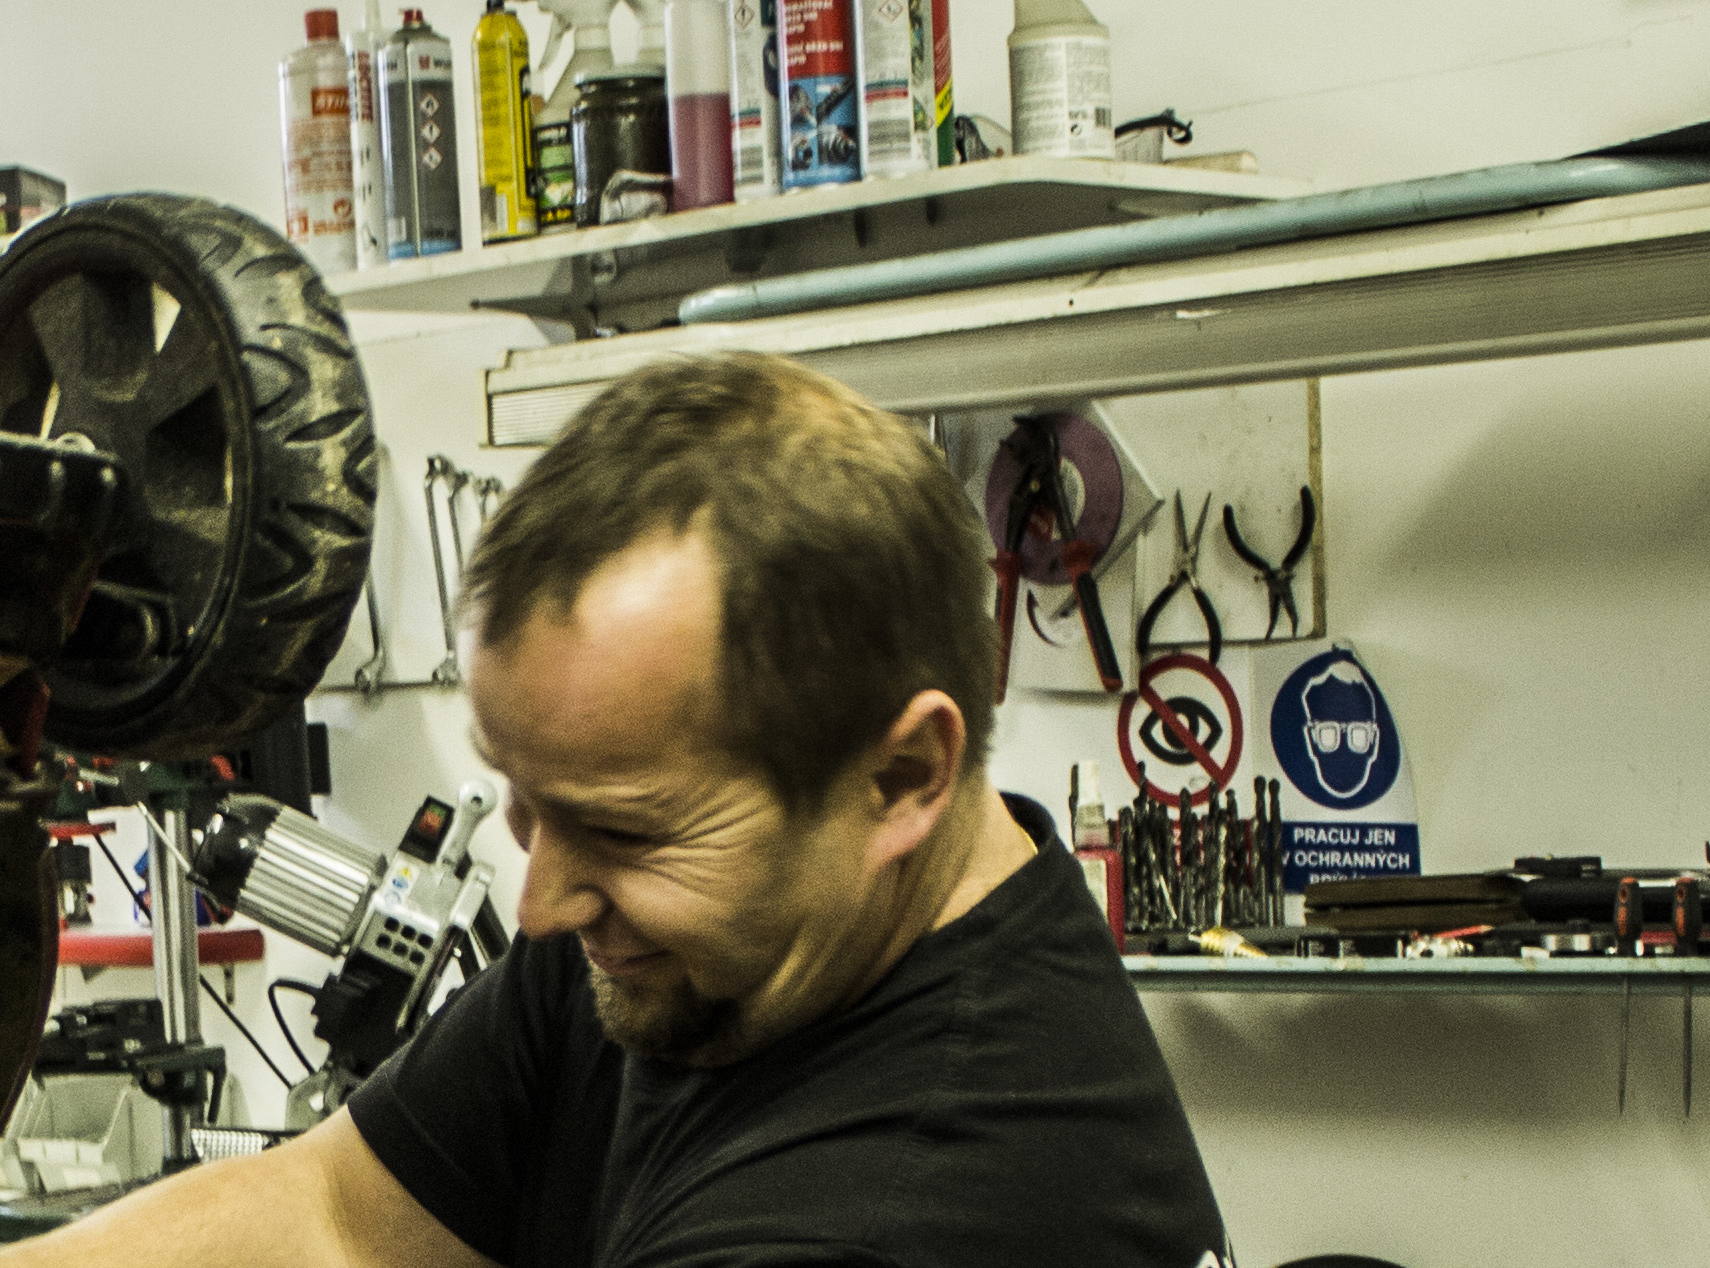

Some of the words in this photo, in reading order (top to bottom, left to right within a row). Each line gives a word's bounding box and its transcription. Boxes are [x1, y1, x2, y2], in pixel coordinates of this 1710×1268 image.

[1293, 827, 1360, 845] PRACUJ
[1365, 829, 1395, 845] JEN
[1294, 849, 1410, 869] OCHRANNÝCH
